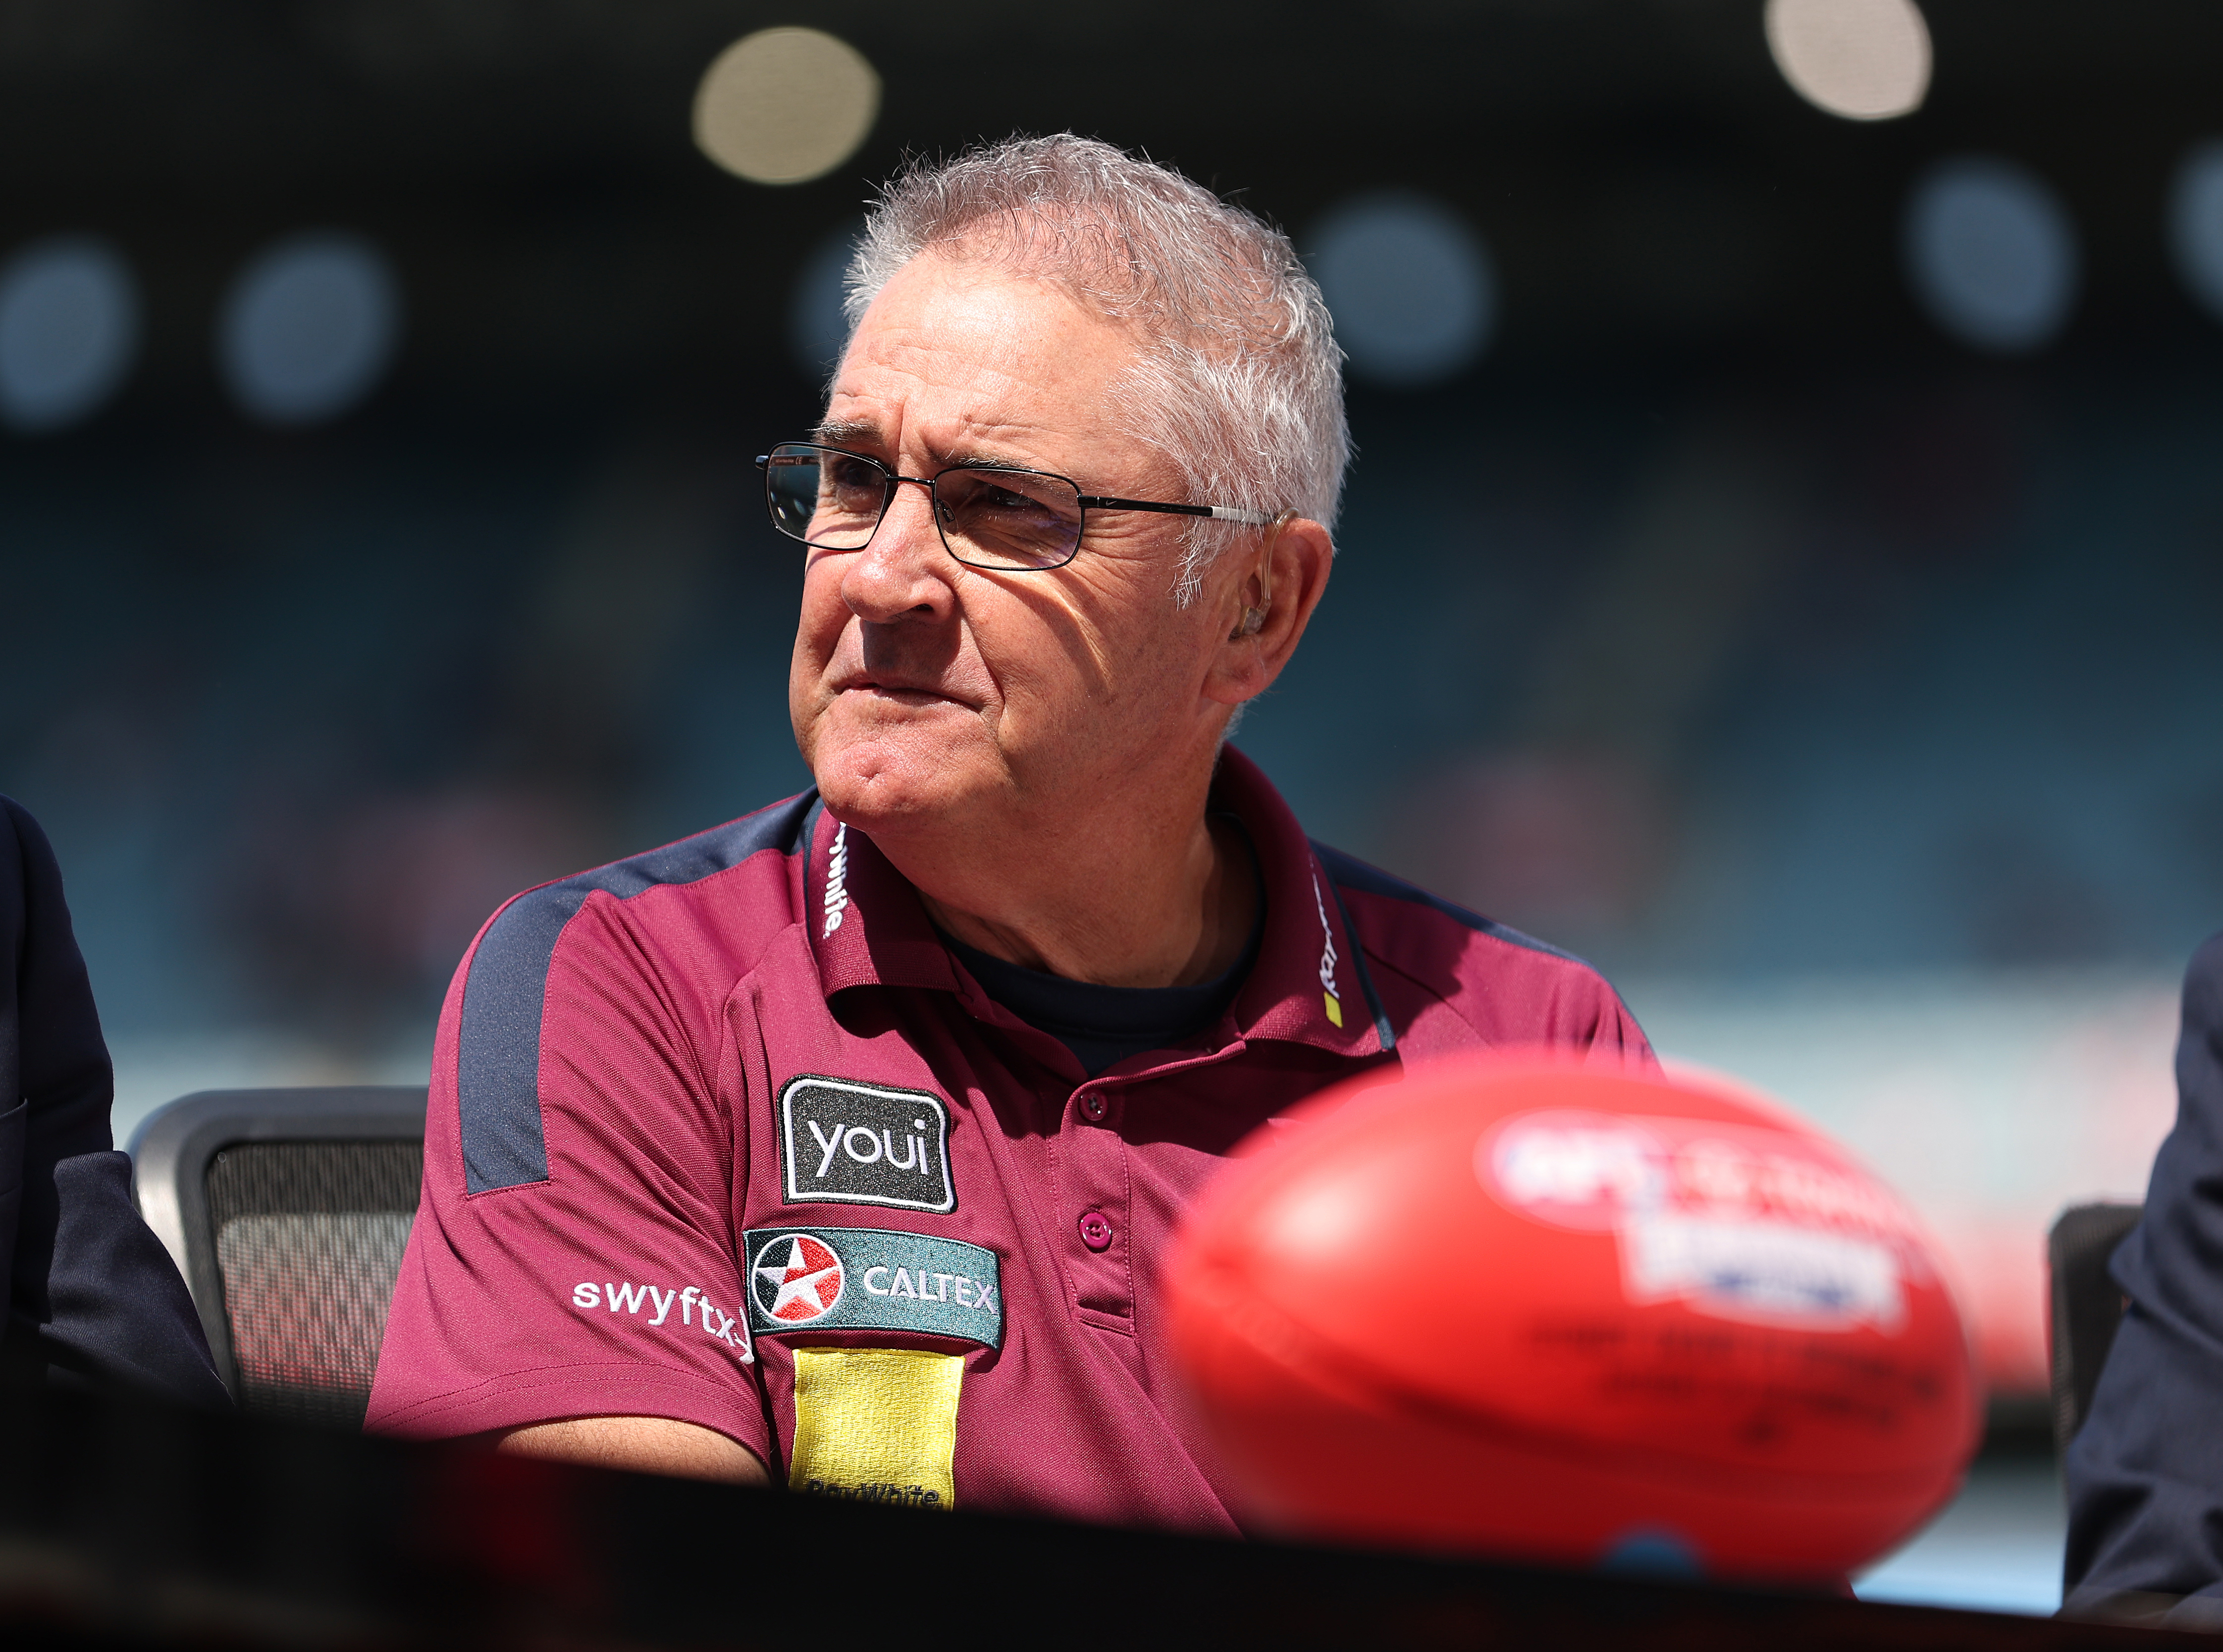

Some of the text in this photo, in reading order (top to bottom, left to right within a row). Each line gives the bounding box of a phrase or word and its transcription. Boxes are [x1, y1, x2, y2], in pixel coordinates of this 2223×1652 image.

[807, 1118, 929, 1178] youi
[572, 1281, 736, 1347] swyftx
[863, 1265, 999, 1316] CALTEX
